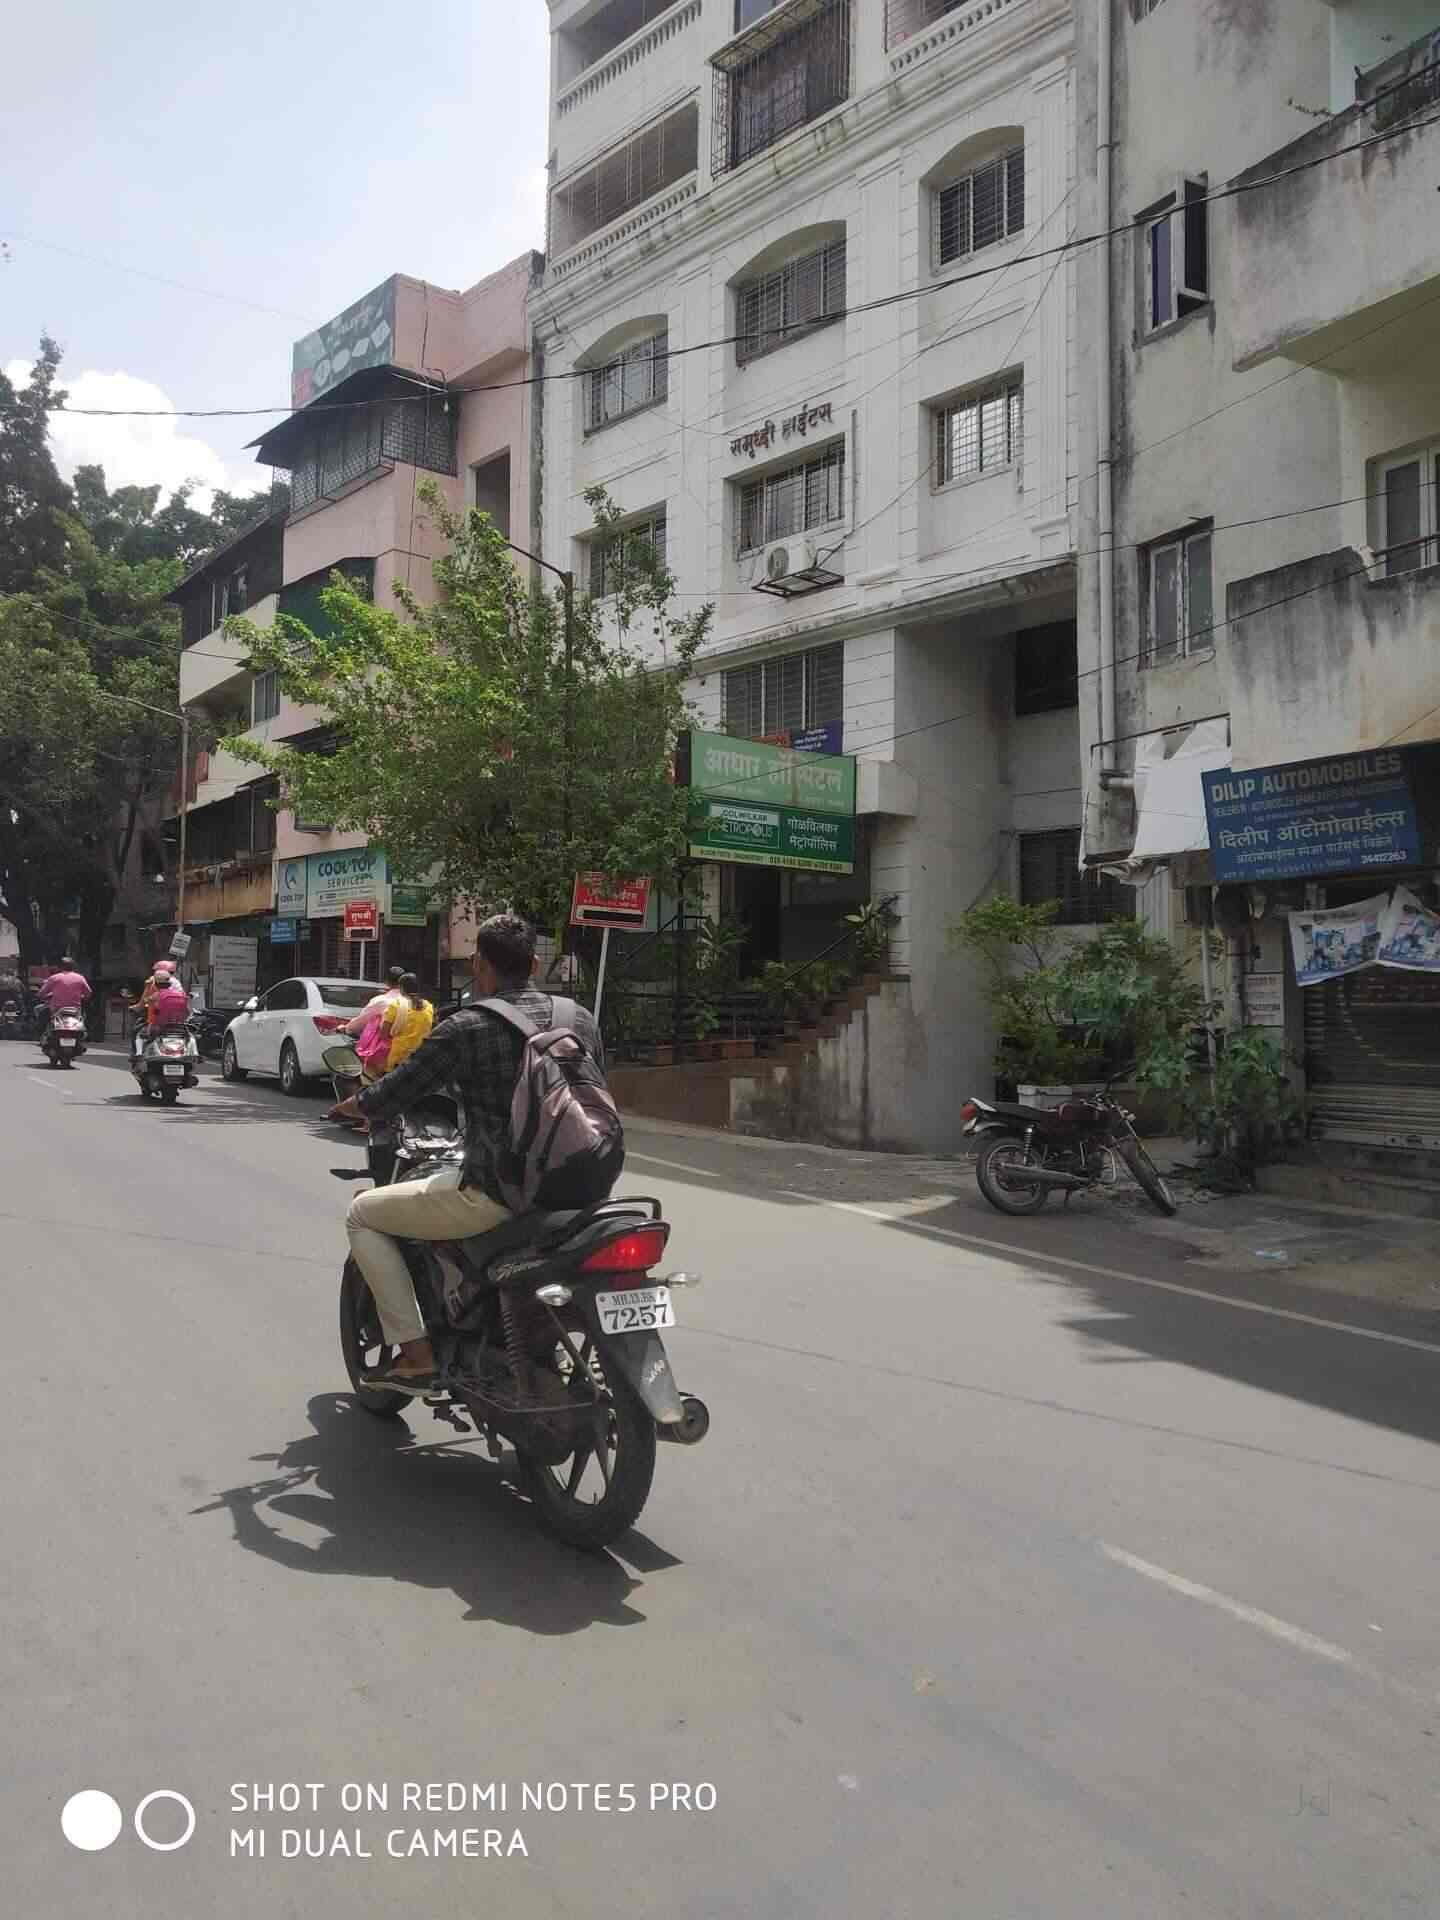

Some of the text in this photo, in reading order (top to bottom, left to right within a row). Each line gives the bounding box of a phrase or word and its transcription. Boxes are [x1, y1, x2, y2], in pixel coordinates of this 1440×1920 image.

[1211, 779, 1256, 802] DILIP
[1262, 752, 1401, 795] AUTOMOBILES
[1219, 825, 1269, 850] दिलीप
[318, 855, 377, 877] COOL TOP
[604, 1303, 667, 1330] 7257
